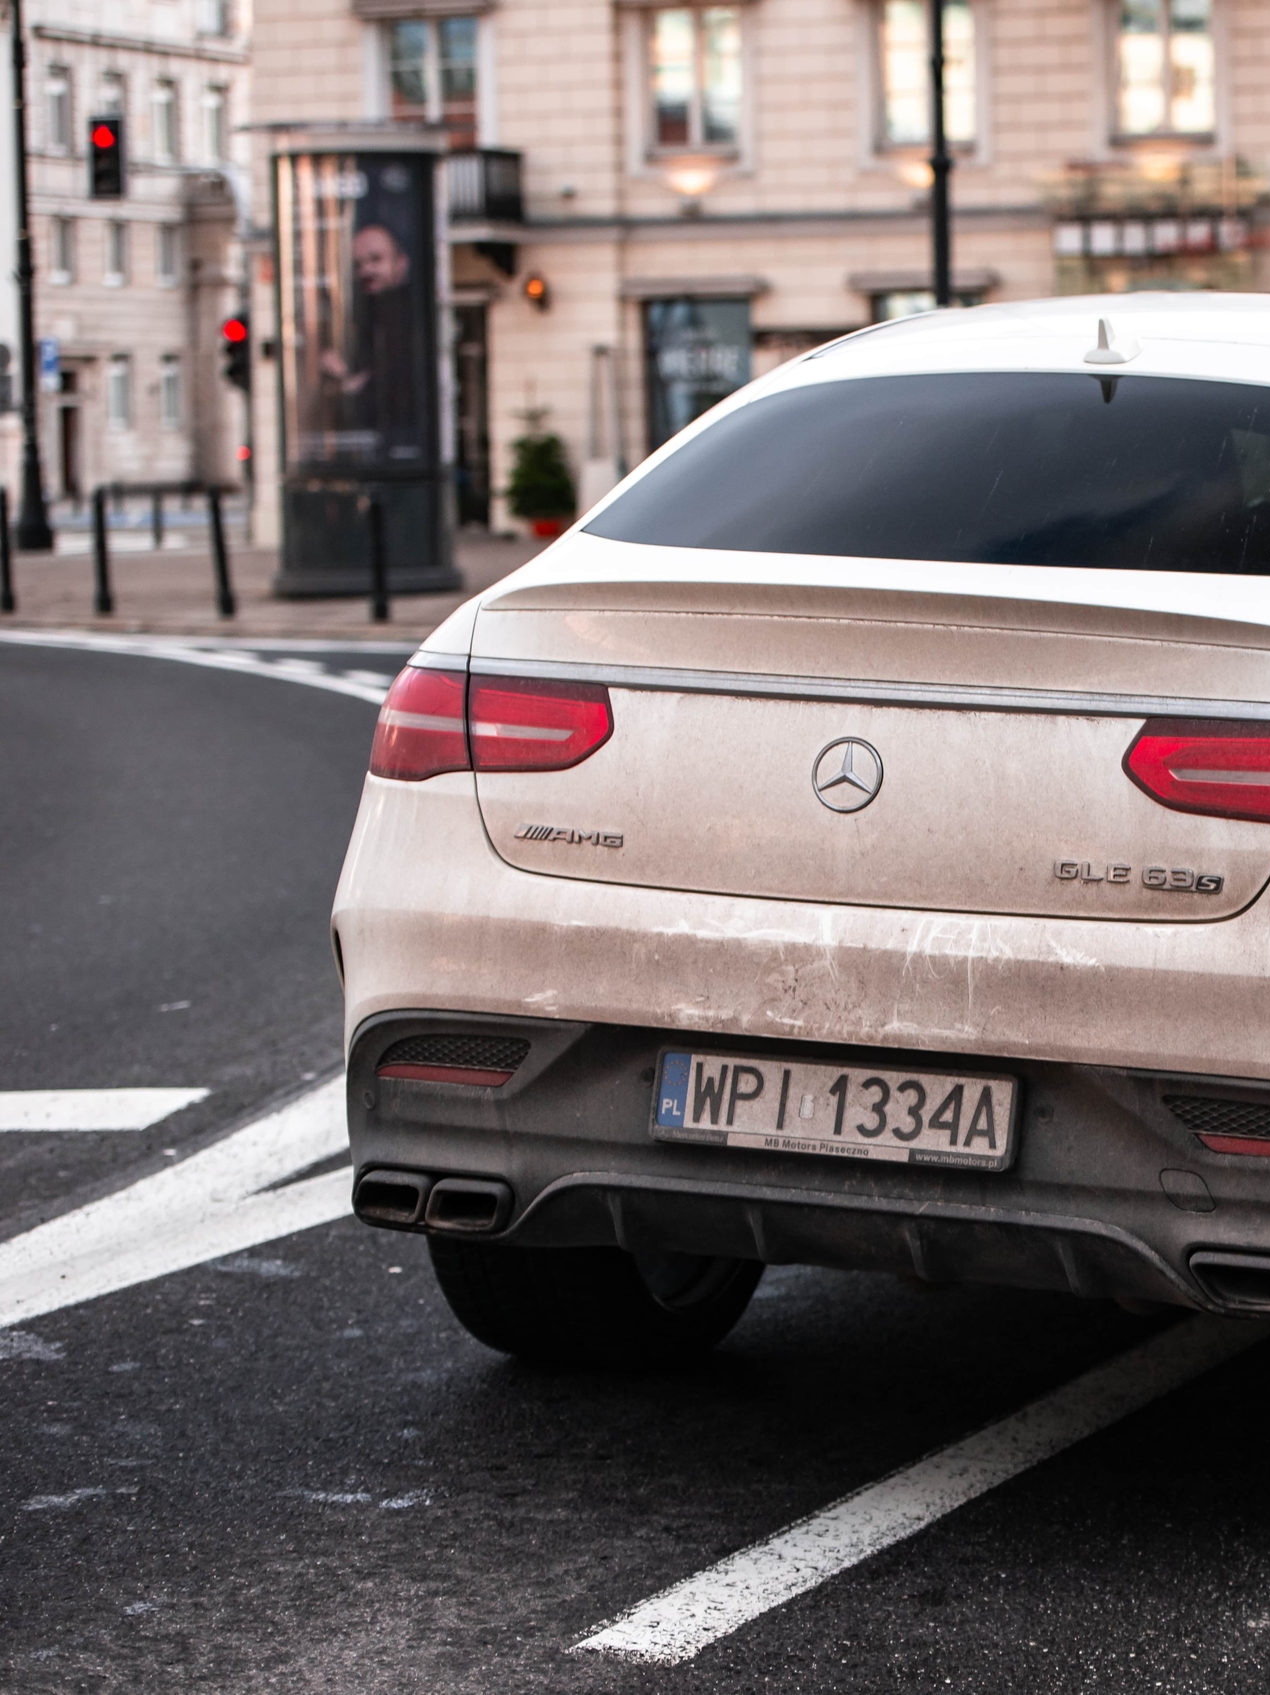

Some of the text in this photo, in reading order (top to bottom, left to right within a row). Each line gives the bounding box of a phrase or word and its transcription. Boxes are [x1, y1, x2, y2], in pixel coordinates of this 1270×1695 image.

[547, 827, 624, 848] AMG
[1054, 859, 1132, 884] GLE
[661, 1098, 682, 1116] PL
[692, 1061, 998, 1150] WPI 1334A
[764, 1137, 870, 1157] MB Motors Piaseczno
[915, 1152, 998, 1169] www.mbmotors.pl
